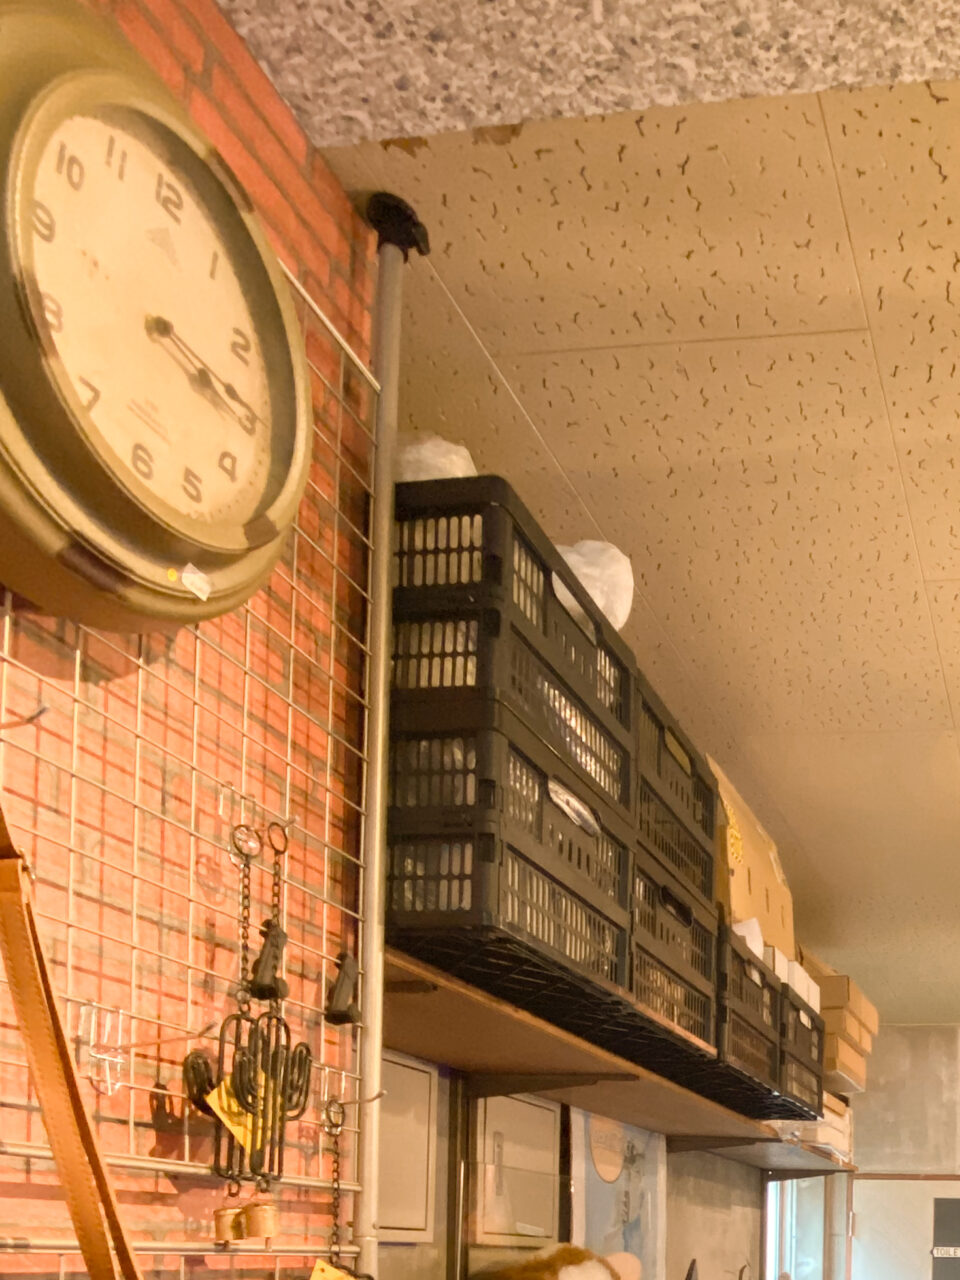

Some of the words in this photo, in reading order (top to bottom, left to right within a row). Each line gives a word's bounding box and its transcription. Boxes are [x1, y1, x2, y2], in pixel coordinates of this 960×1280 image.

[56, 140, 85, 192] 10
[104, 134, 128, 182] 11
[155, 172, 184, 225] 12
[31, 199, 56, 243] 9
[209, 250, 219, 281] 1
[230, 327, 252, 367] 2
[78, 375, 101, 414] 7
[237, 404, 258, 436] 3
[131, 443, 155, 481] 6
[217, 450, 238, 484] 4
[182, 466, 203, 504] 5
